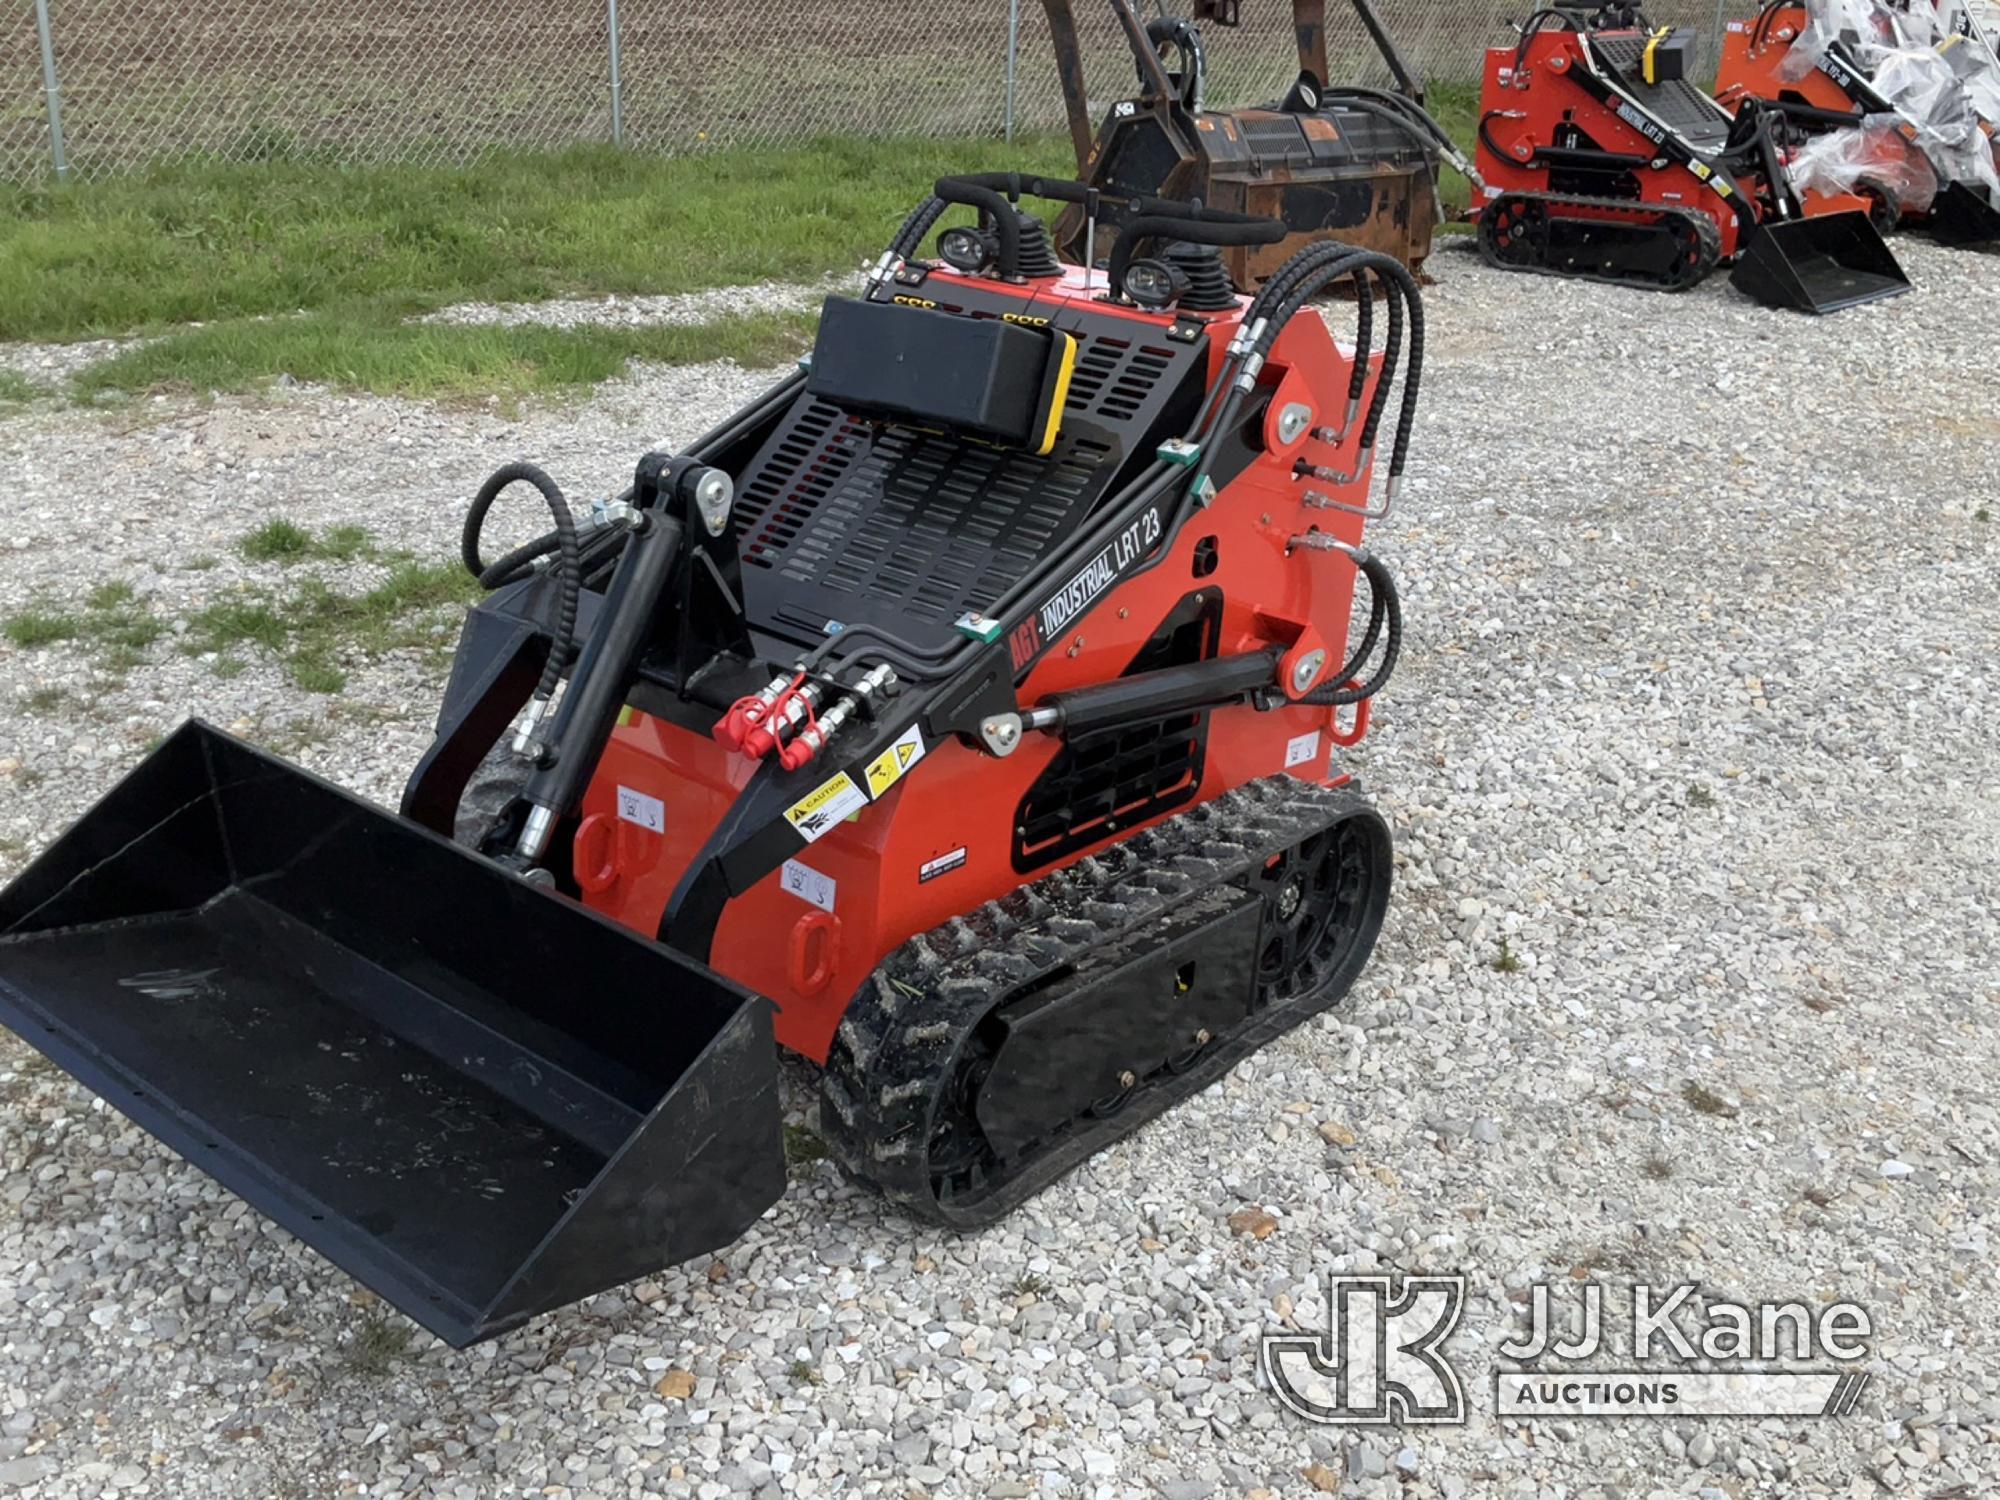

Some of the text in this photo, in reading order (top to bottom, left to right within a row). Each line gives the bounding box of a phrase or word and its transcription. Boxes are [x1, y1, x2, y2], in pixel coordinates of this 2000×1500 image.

[1114, 522, 1140, 571] LRT
[1142, 507, 1160, 545] 23
[806, 778, 845, 808] CAUTION
